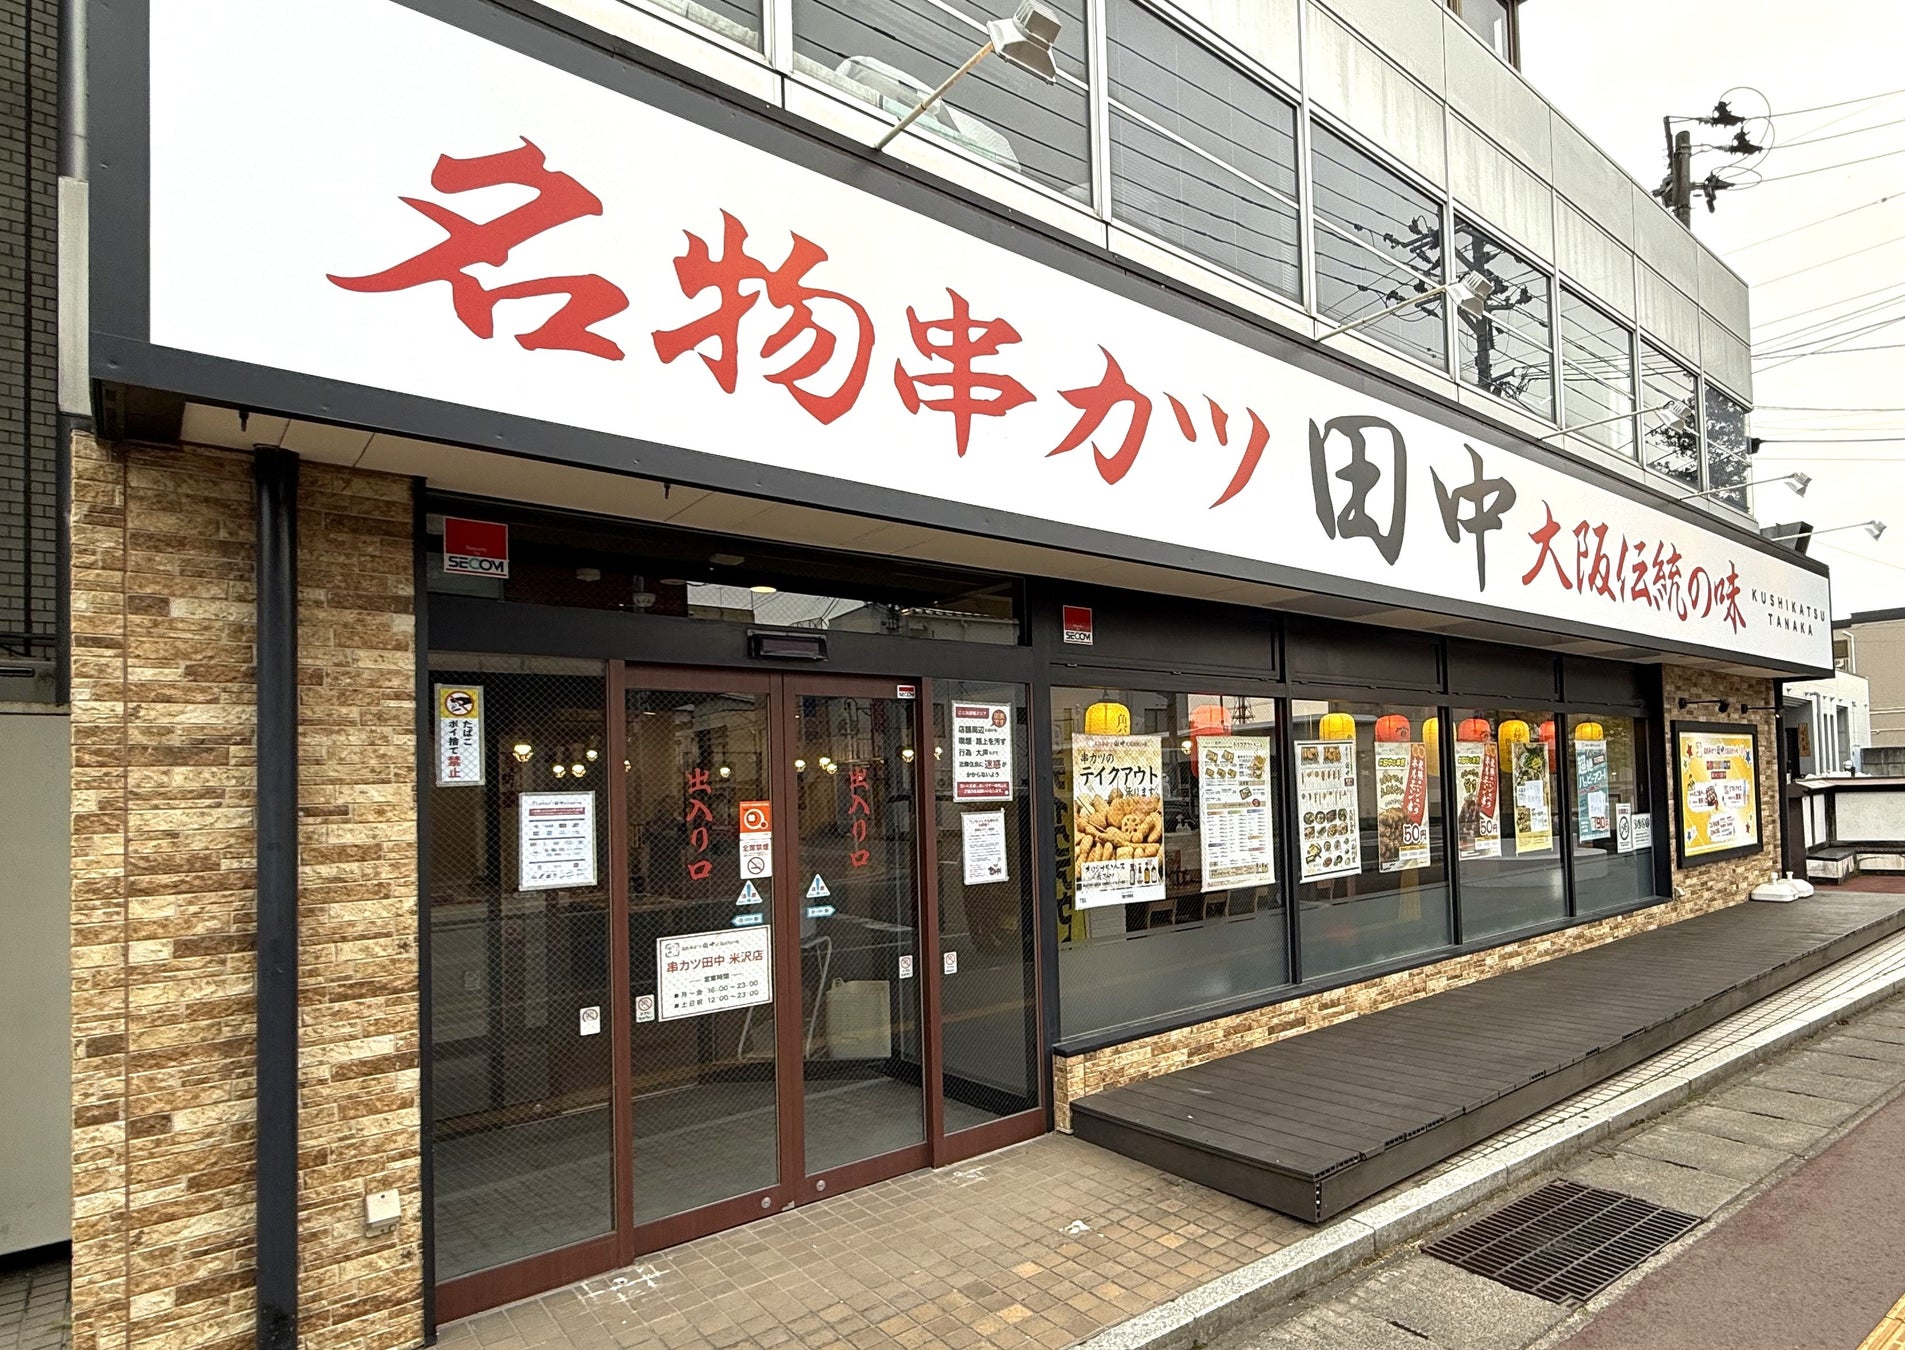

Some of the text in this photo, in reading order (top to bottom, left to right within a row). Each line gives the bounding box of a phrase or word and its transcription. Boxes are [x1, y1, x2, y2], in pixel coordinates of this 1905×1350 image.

[448, 555, 504, 573] SECOM
[1522, 499, 1746, 635] 大阪伝統の味
[1751, 587, 1827, 622] KUSHIKATSU
[1065, 631, 1091, 641] SECOM
[1767, 612, 1814, 637] TANAKA
[462, 720, 473, 746] たばこ
[1080, 752, 1115, 765] 串カツの
[1080, 766, 1158, 786] テイクアウト
[686, 768, 713, 880] 出入り口
[848, 766, 870, 867] 出入り口
[1403, 824, 1427, 844] 50円
[667, 949, 764, 973] 串カツ田中 米沢店
